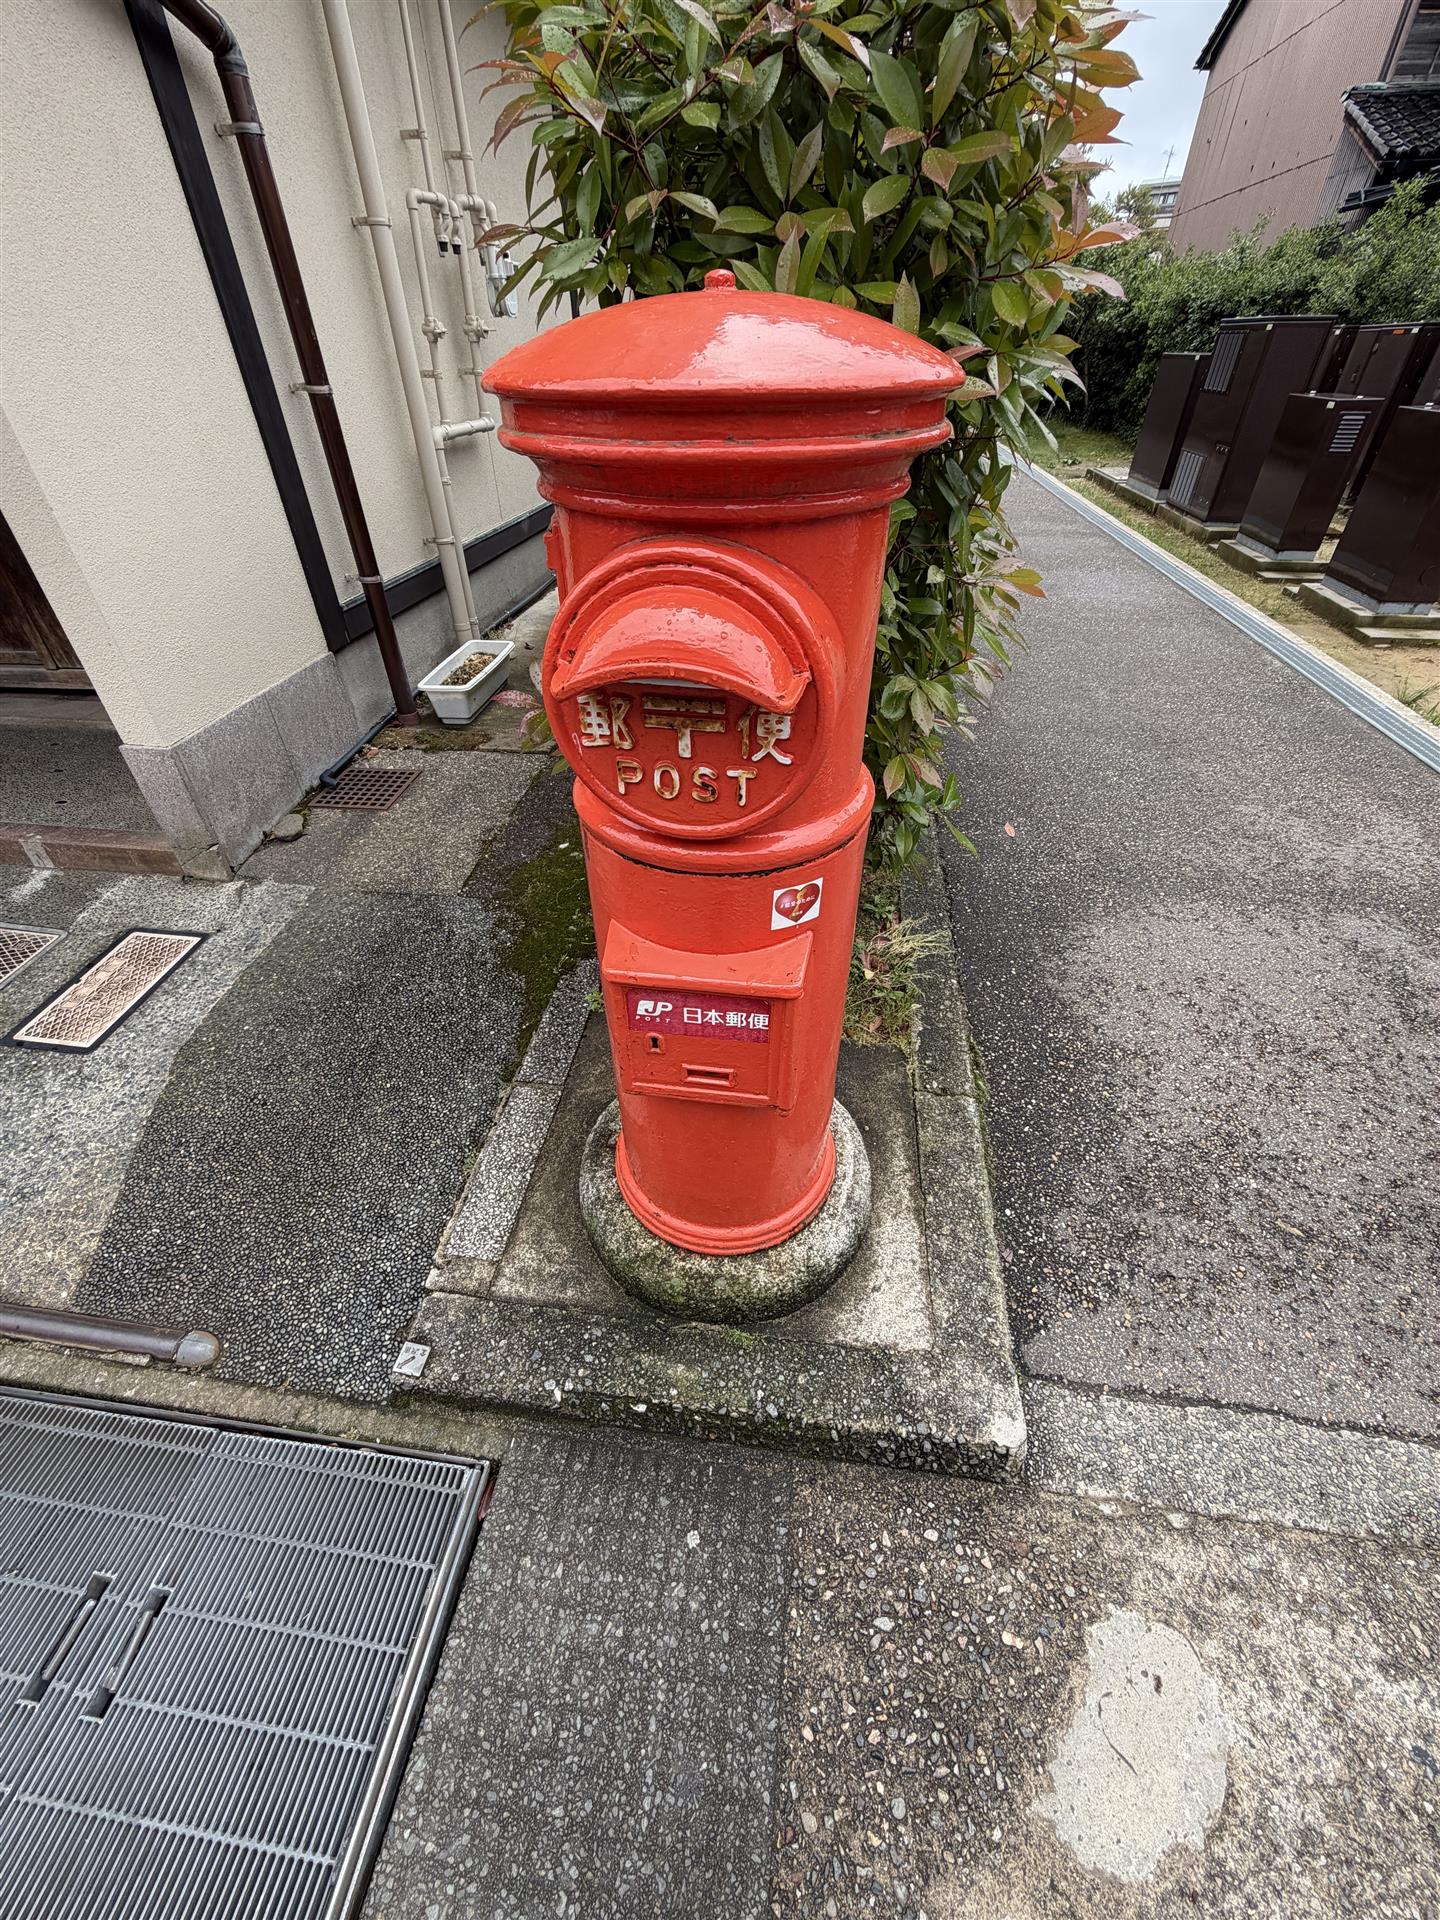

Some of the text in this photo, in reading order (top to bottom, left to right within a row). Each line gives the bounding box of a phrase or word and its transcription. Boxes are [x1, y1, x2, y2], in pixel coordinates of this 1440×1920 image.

[616, 756, 757, 807] POST
[637, 1000, 673, 1016] JP
[683, 1007, 769, 1030] 日本郵便
